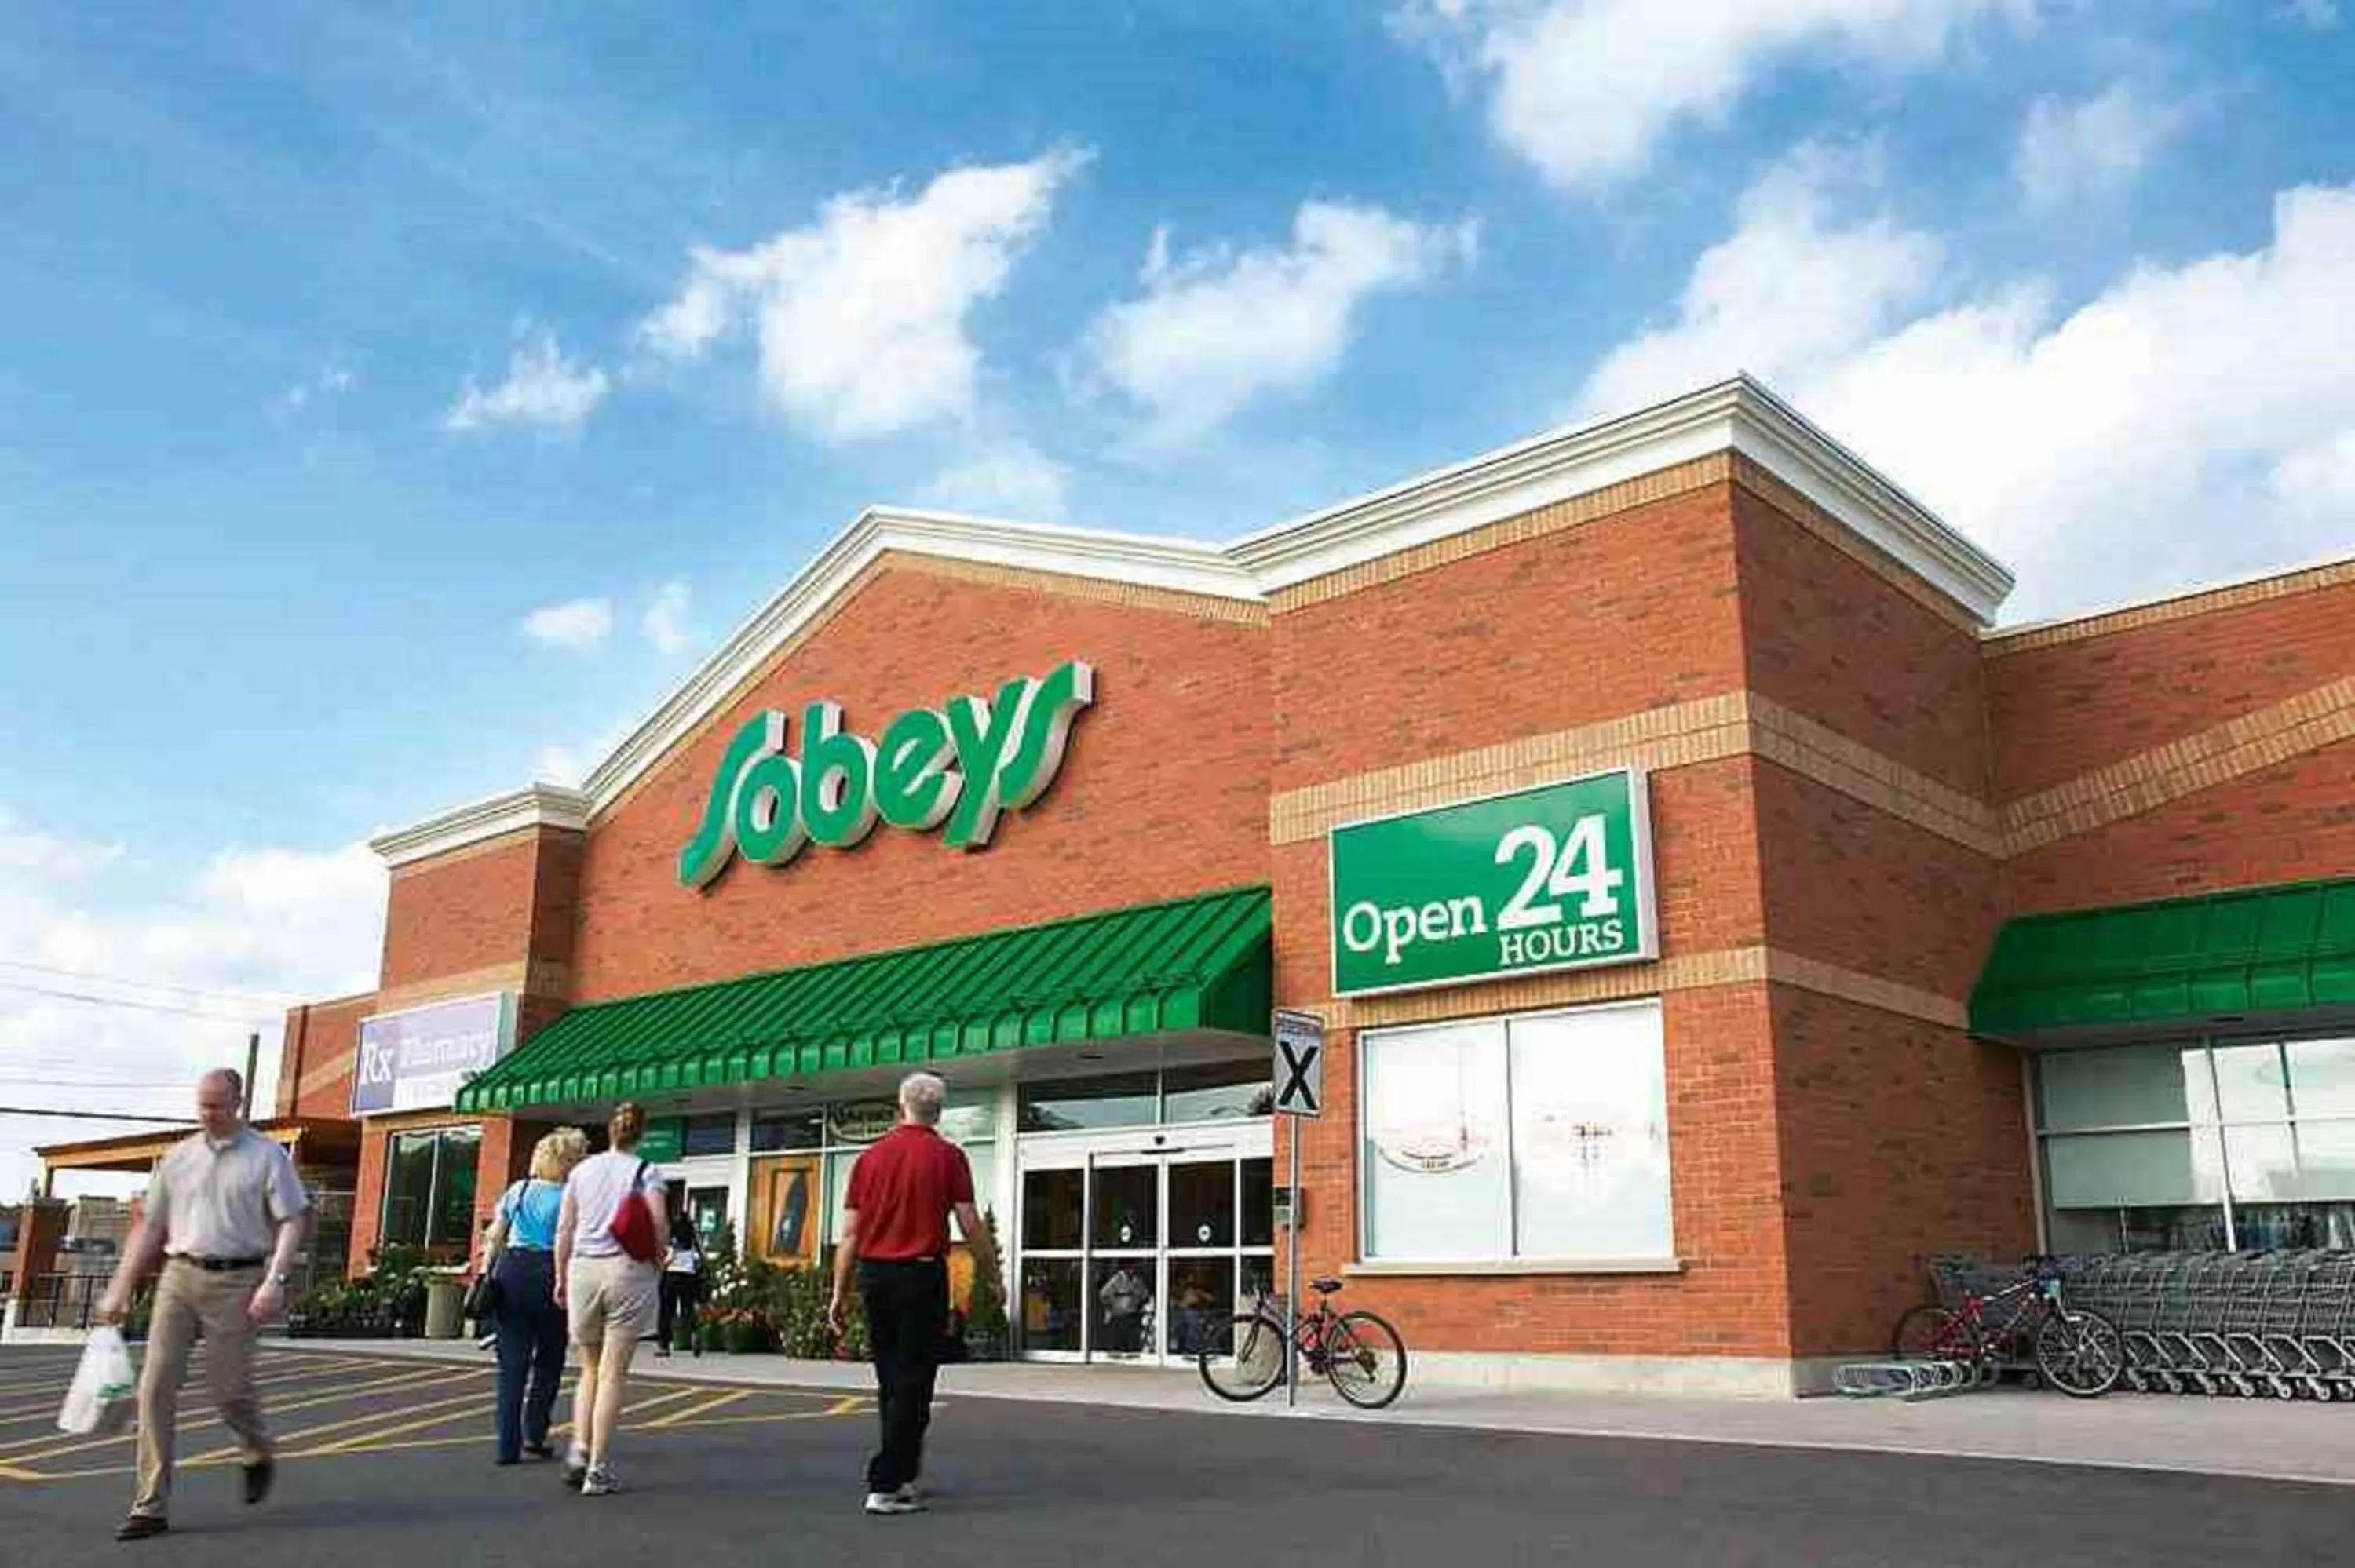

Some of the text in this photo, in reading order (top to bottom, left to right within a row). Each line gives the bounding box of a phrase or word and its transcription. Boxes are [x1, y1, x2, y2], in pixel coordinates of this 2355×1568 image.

[677, 659, 1094, 888] Sobeys
[1343, 813, 1623, 964] Open 24
[1499, 920, 1624, 965] HOURS
[360, 1041, 392, 1085] Rx
